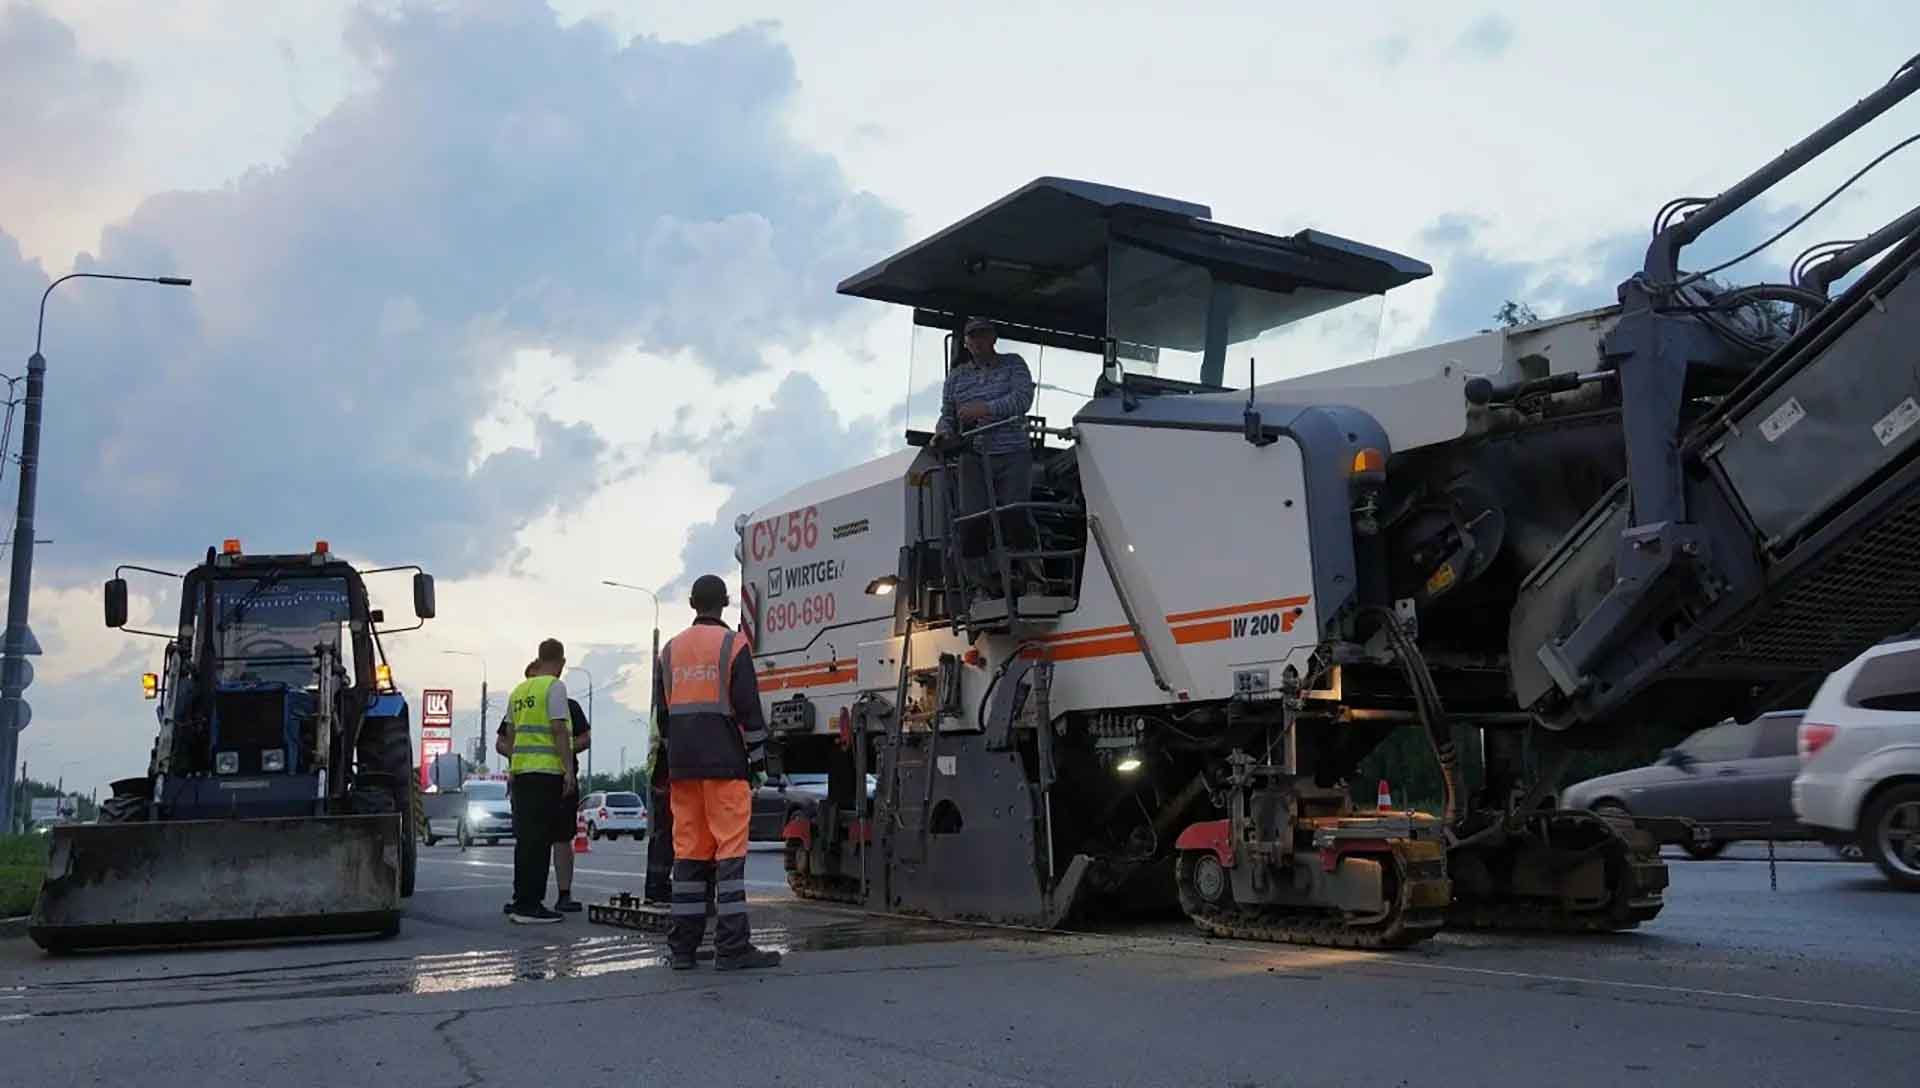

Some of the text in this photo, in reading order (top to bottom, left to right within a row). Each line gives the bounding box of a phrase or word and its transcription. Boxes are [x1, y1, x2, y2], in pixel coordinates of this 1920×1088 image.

[752, 505, 818, 562] СУ-56
[766, 592, 836, 633] 690-690
[1233, 613, 1280, 638] W 200
[427, 694, 449, 715] LUK
